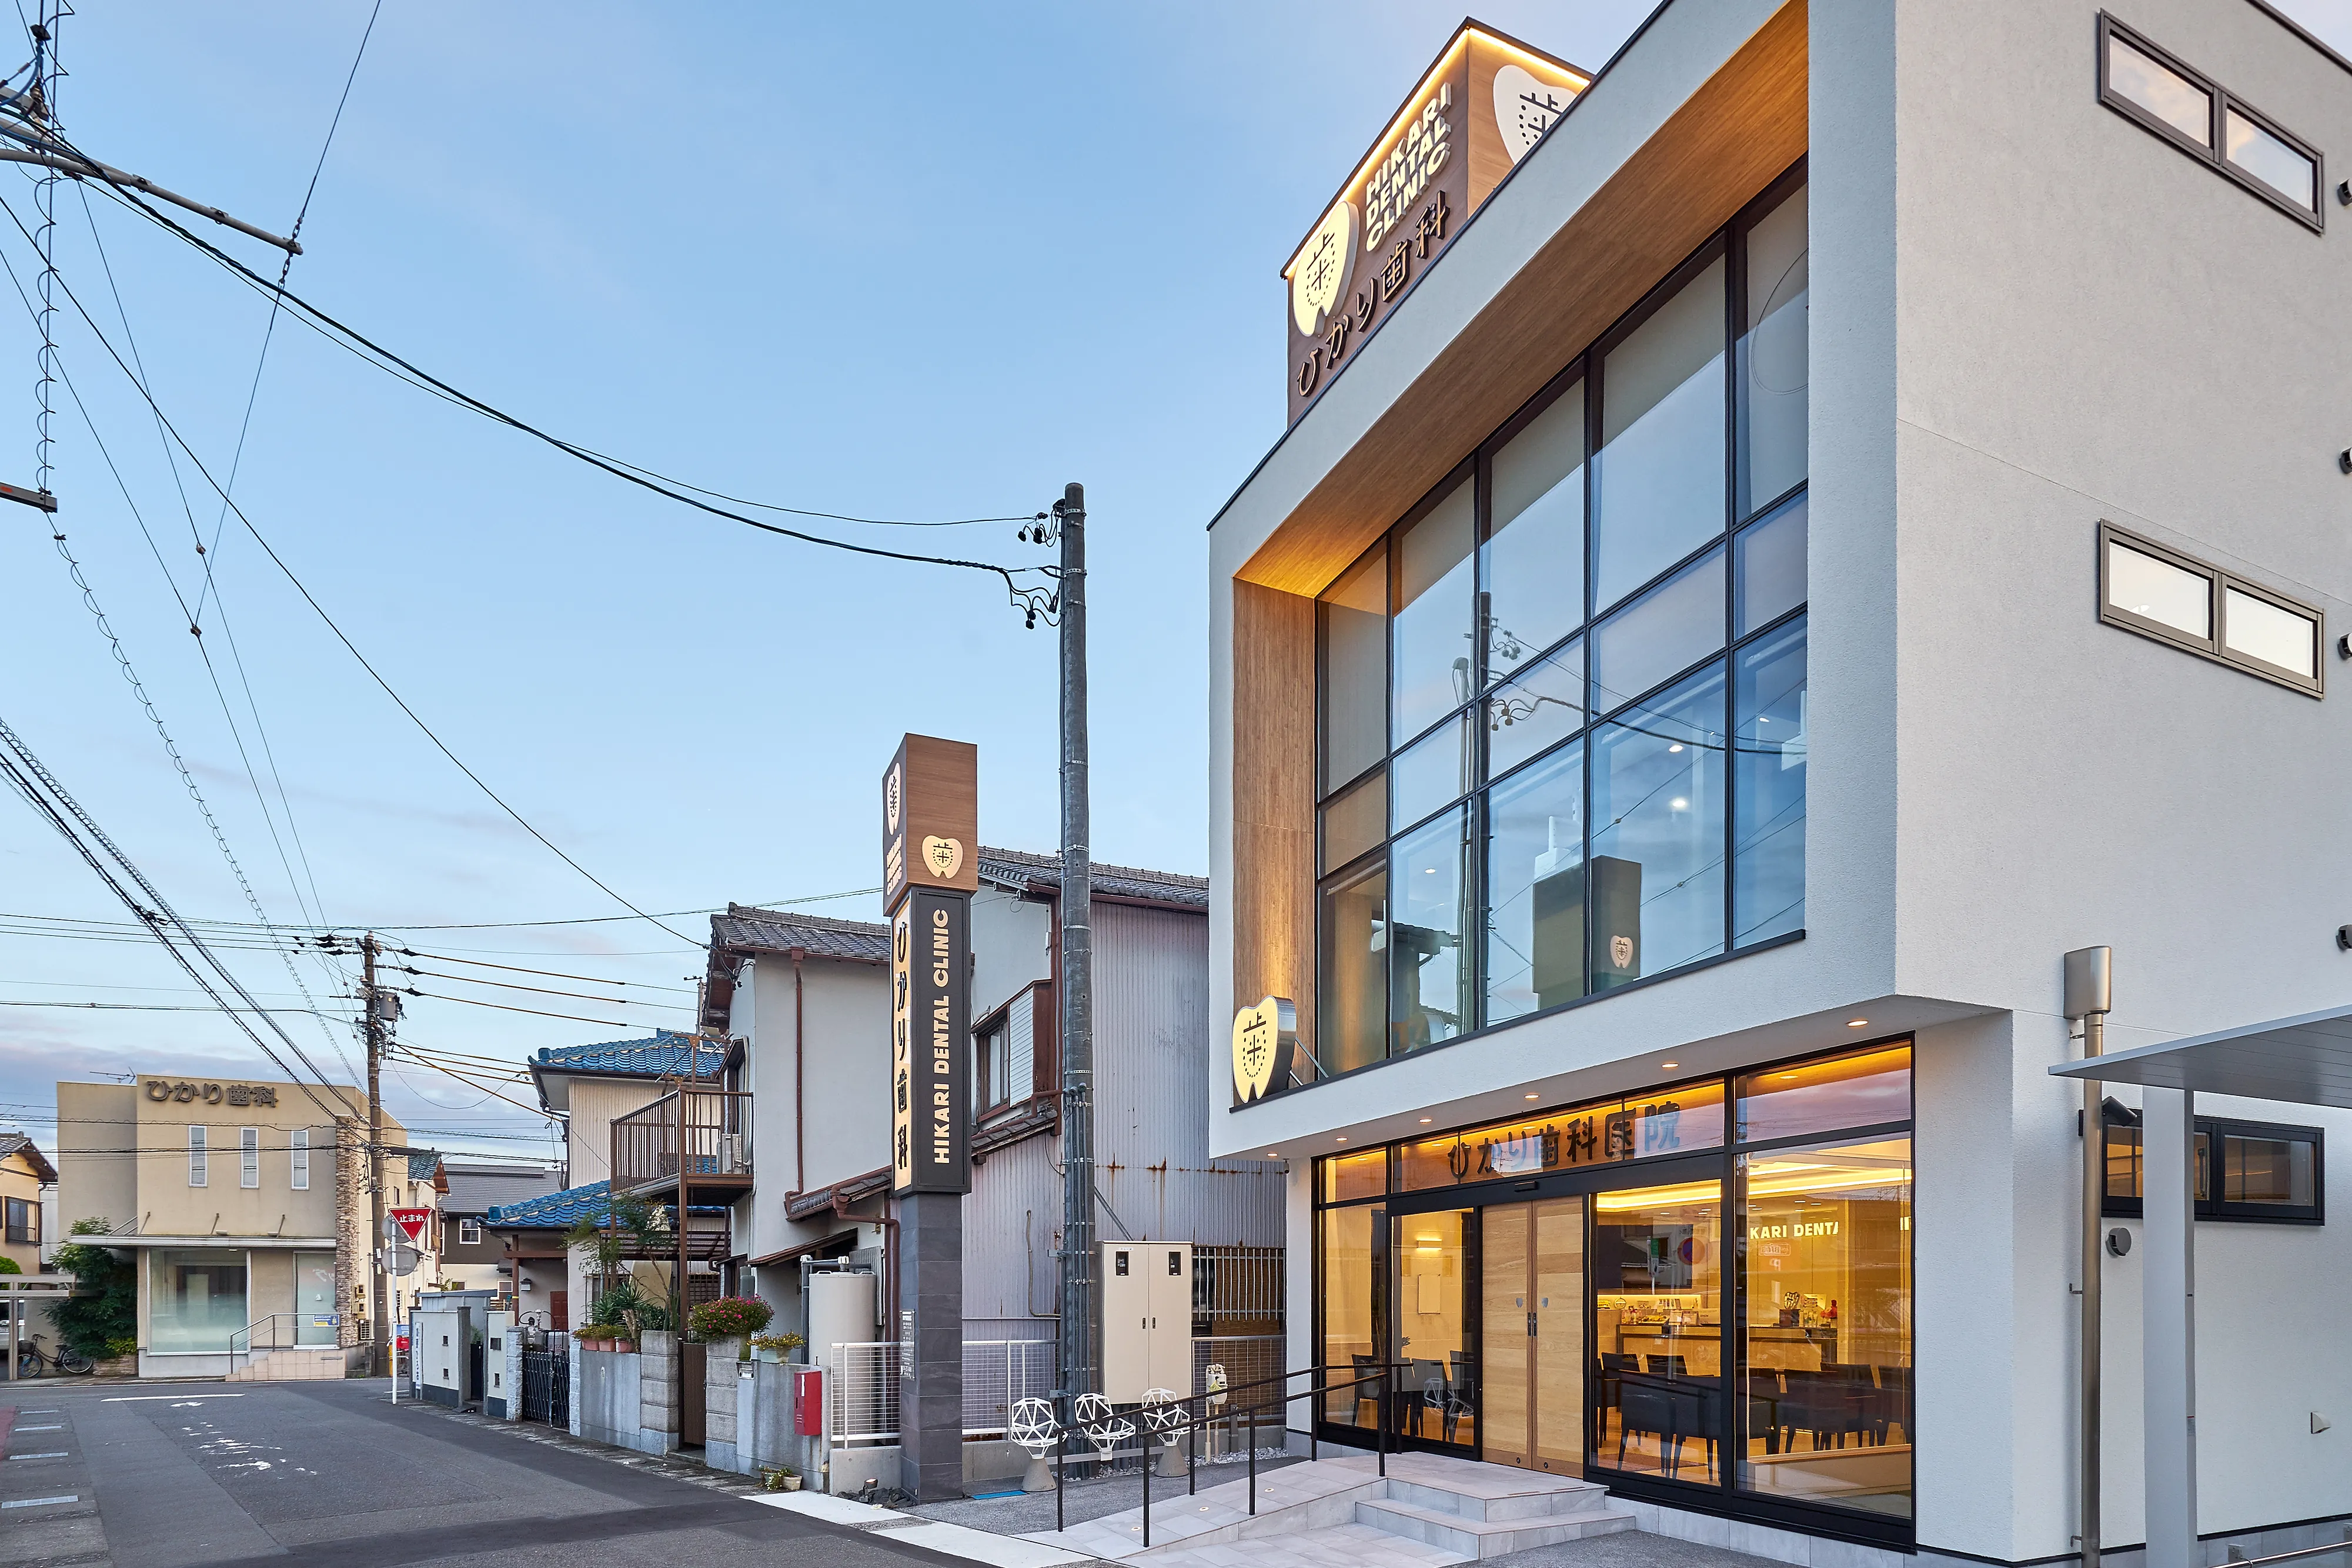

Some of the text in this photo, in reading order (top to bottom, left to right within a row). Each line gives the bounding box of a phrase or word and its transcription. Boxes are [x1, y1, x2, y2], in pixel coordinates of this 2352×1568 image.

[1366, 82, 1451, 206] HIKARI
[1366, 116, 1451, 232] DENTAL
[1366, 142, 1451, 252] CLINIC
[1297, 190, 1450, 397] ひかり歯科
[146, 1080, 279, 1108] ひかり歯科
[897, 921, 908, 1170] ひかり歯科
[933, 909, 950, 1164] HIKARI DENTAL CLINIC
[1448, 1101, 1681, 1178] ひかり歯科医院
[399, 1214, 425, 1222] 止まれ
